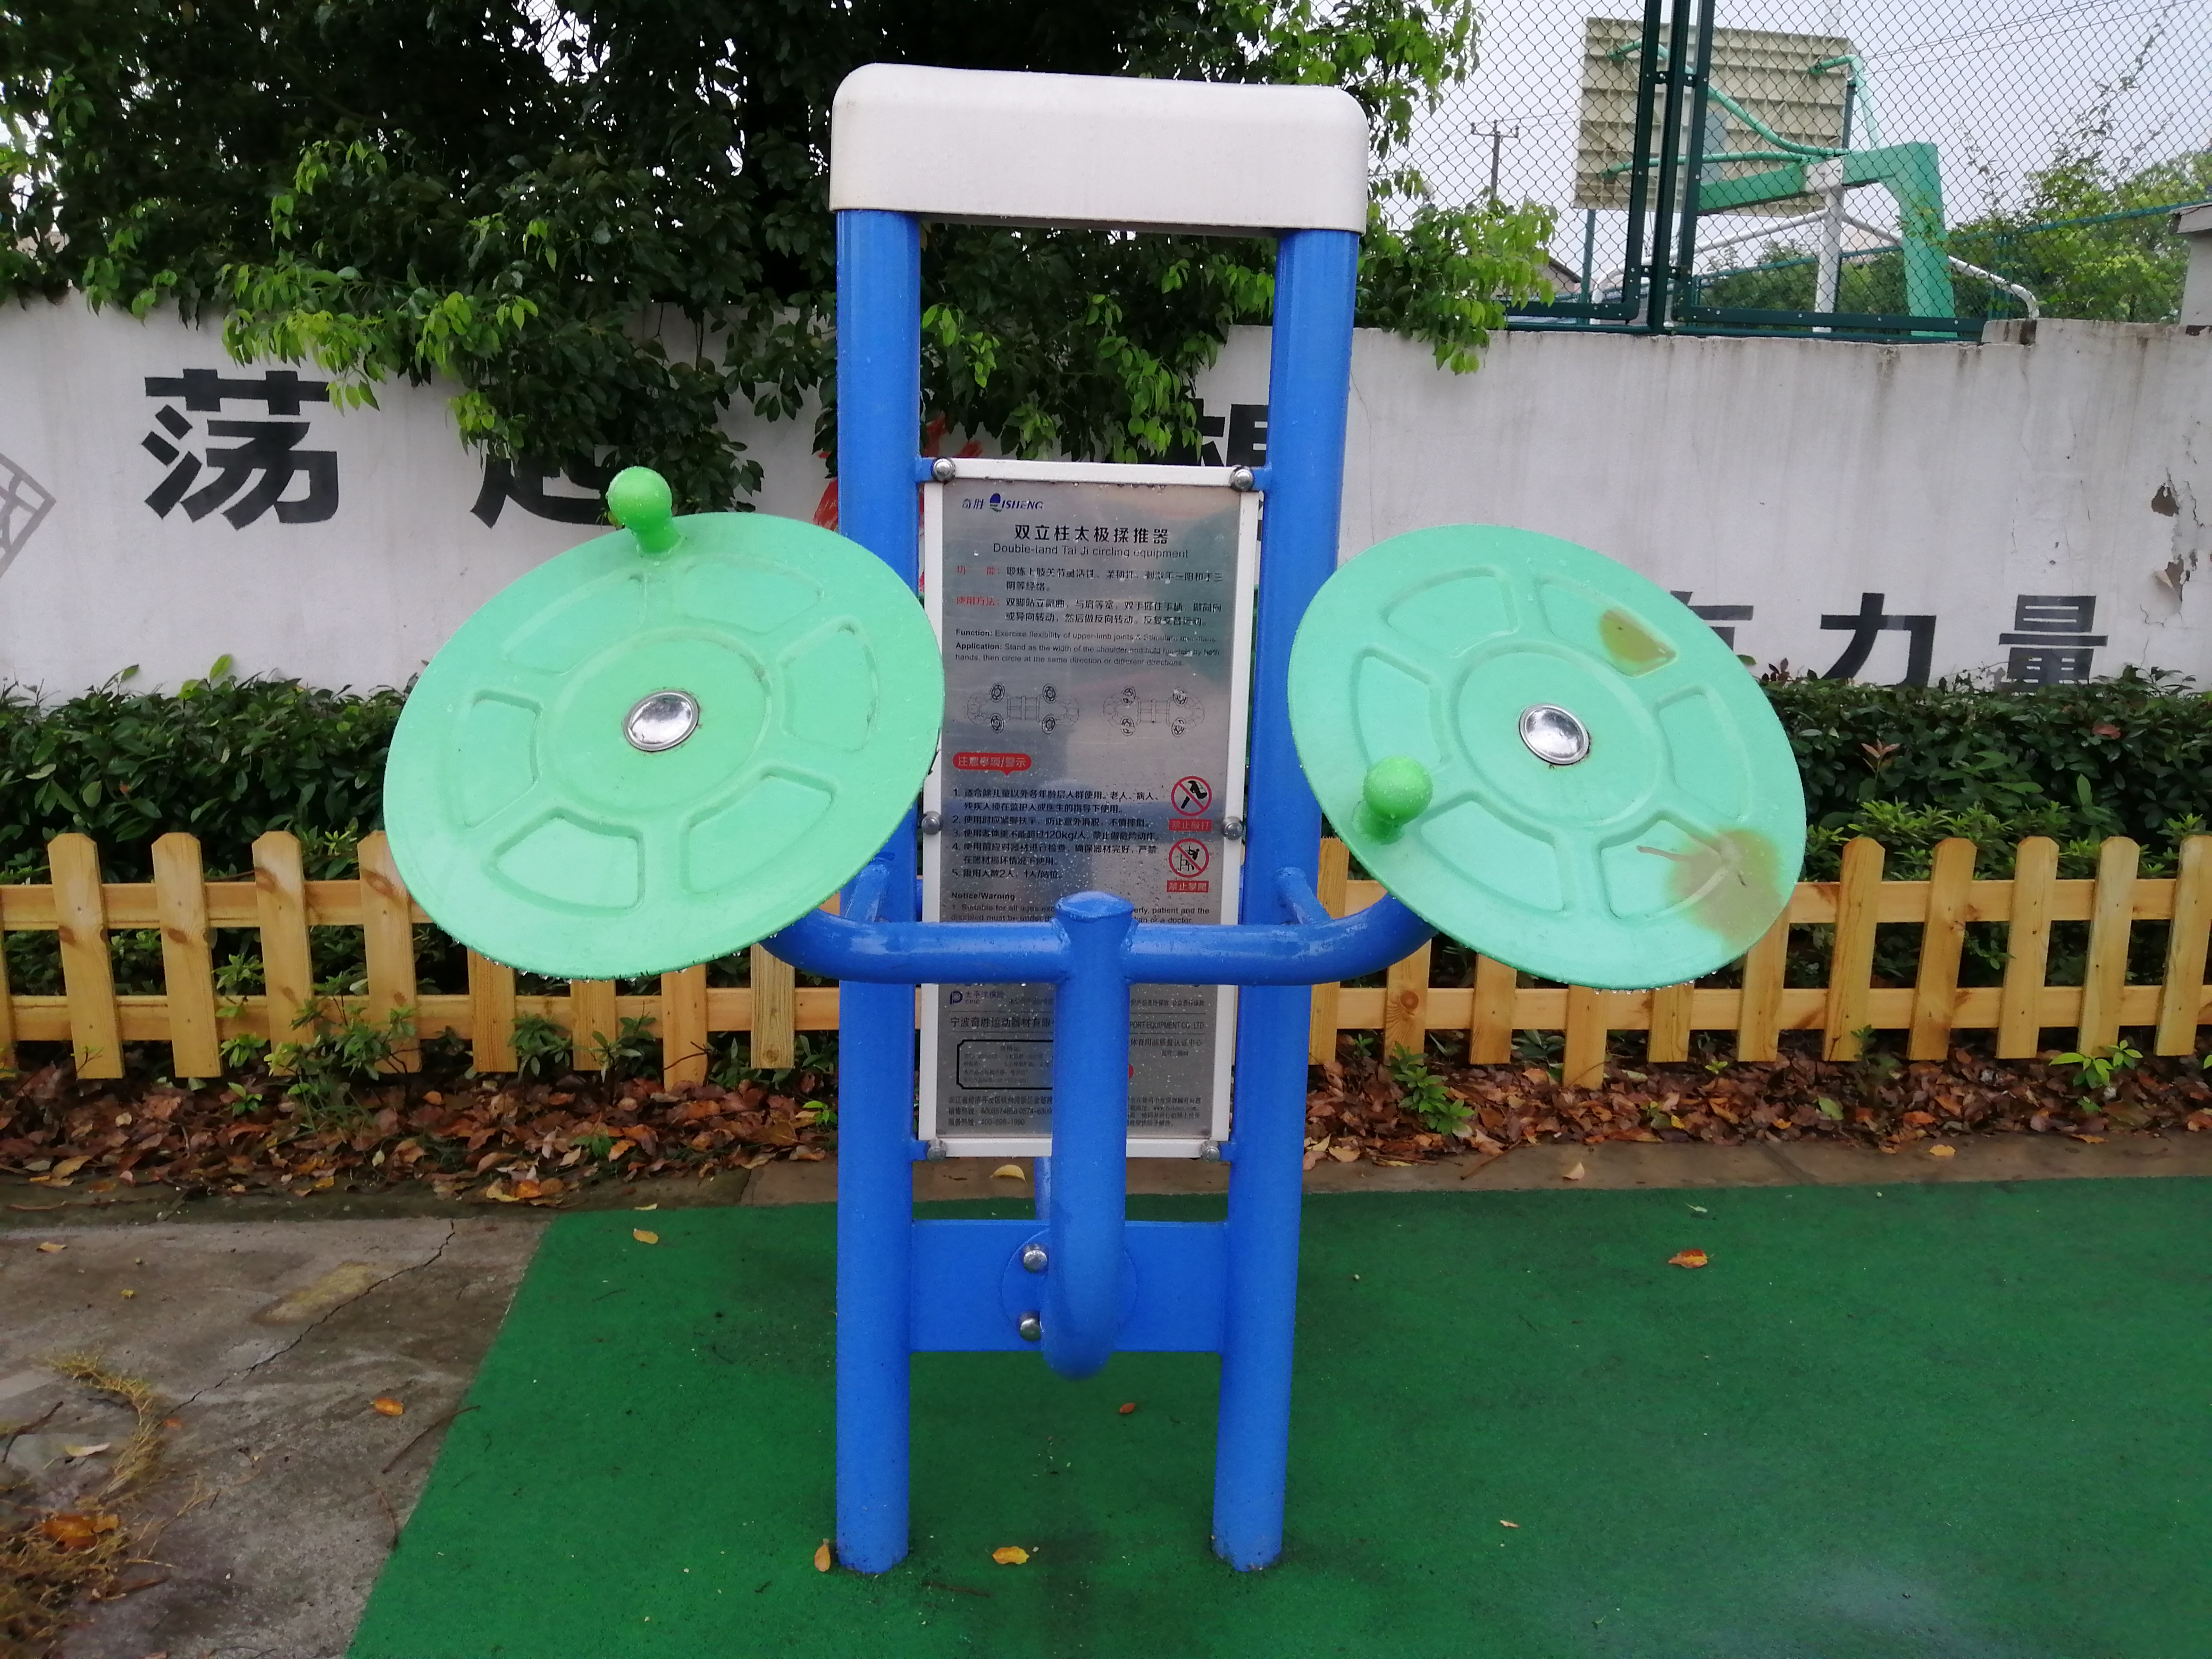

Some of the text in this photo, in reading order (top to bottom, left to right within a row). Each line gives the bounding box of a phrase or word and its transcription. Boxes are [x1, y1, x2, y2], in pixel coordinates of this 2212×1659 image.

[141, 368, 339, 530] 荡
[1015, 524, 1168, 544] 双立柱太极揉推器
[1061, 546, 1077, 556] Tai
[1080, 546, 1088, 556] Ji
[1093, 547, 1129, 558] circling
[1134, 549, 1188, 560] equipment
[1029, 631, 1060, 640] flexibility
[1073, 633, 1111, 641] upper-limb
[1113, 633, 1133, 642] joints
[956, 642, 1002, 651] Application:
[952, 892, 1015, 901] Notice/Warning
[950, 1016, 1054, 1028] 宁波奇胜运动器材有限
[1146, 1021, 1180, 1029] EQUIPMENT
